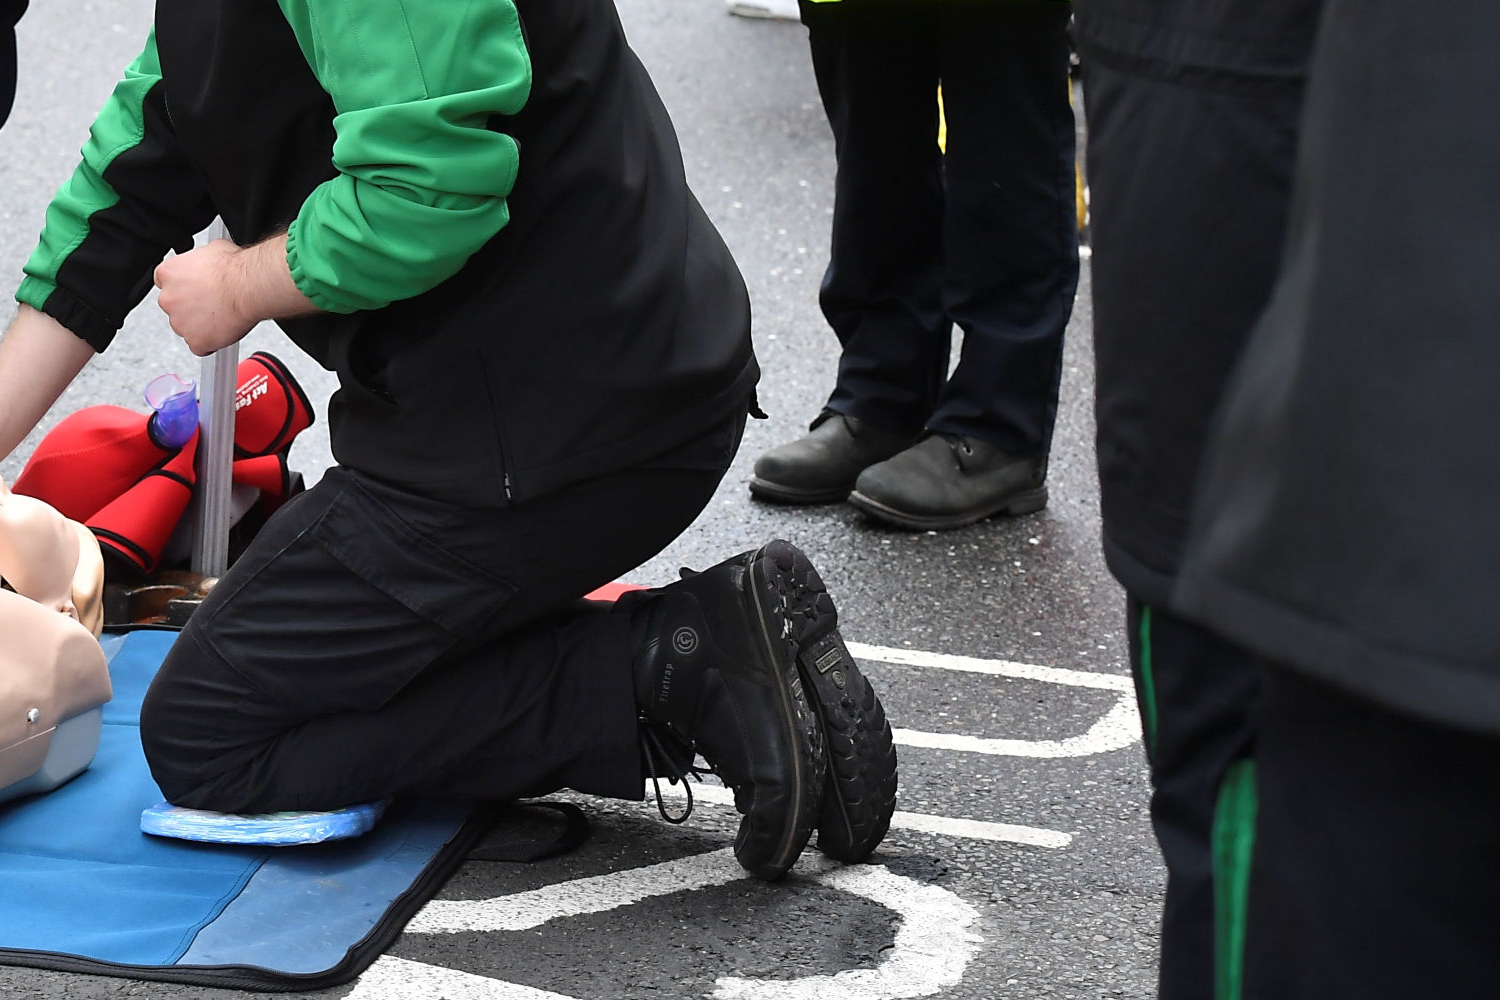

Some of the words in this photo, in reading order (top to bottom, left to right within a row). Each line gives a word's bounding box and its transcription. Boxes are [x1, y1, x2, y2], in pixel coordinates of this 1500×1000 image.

[251, 381, 268, 400] Act
[235, 393, 252, 411] Fas
[659, 663, 674, 702] Firetrap
